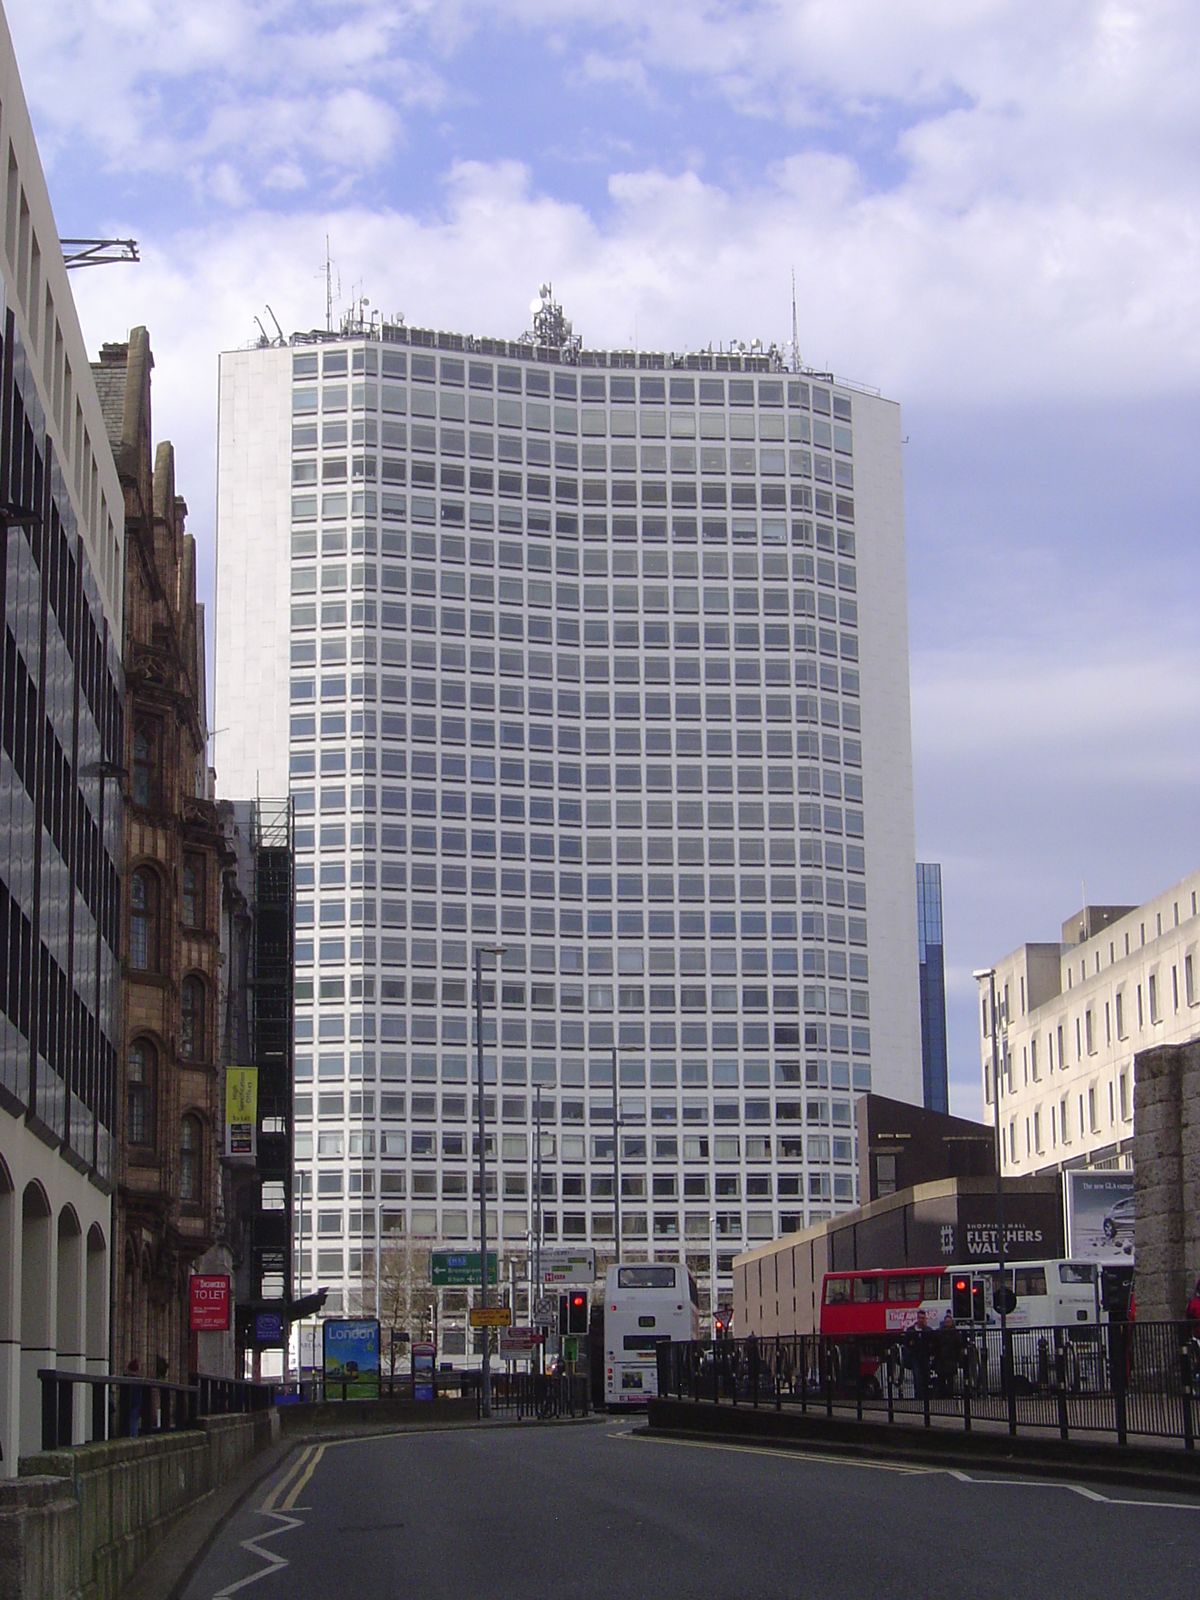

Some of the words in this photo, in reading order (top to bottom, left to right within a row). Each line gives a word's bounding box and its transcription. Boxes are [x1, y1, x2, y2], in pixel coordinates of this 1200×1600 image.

[194, 1290, 207, 1300] TO
[208, 1290, 226, 1300] LET
[329, 1327, 375, 1339] London
